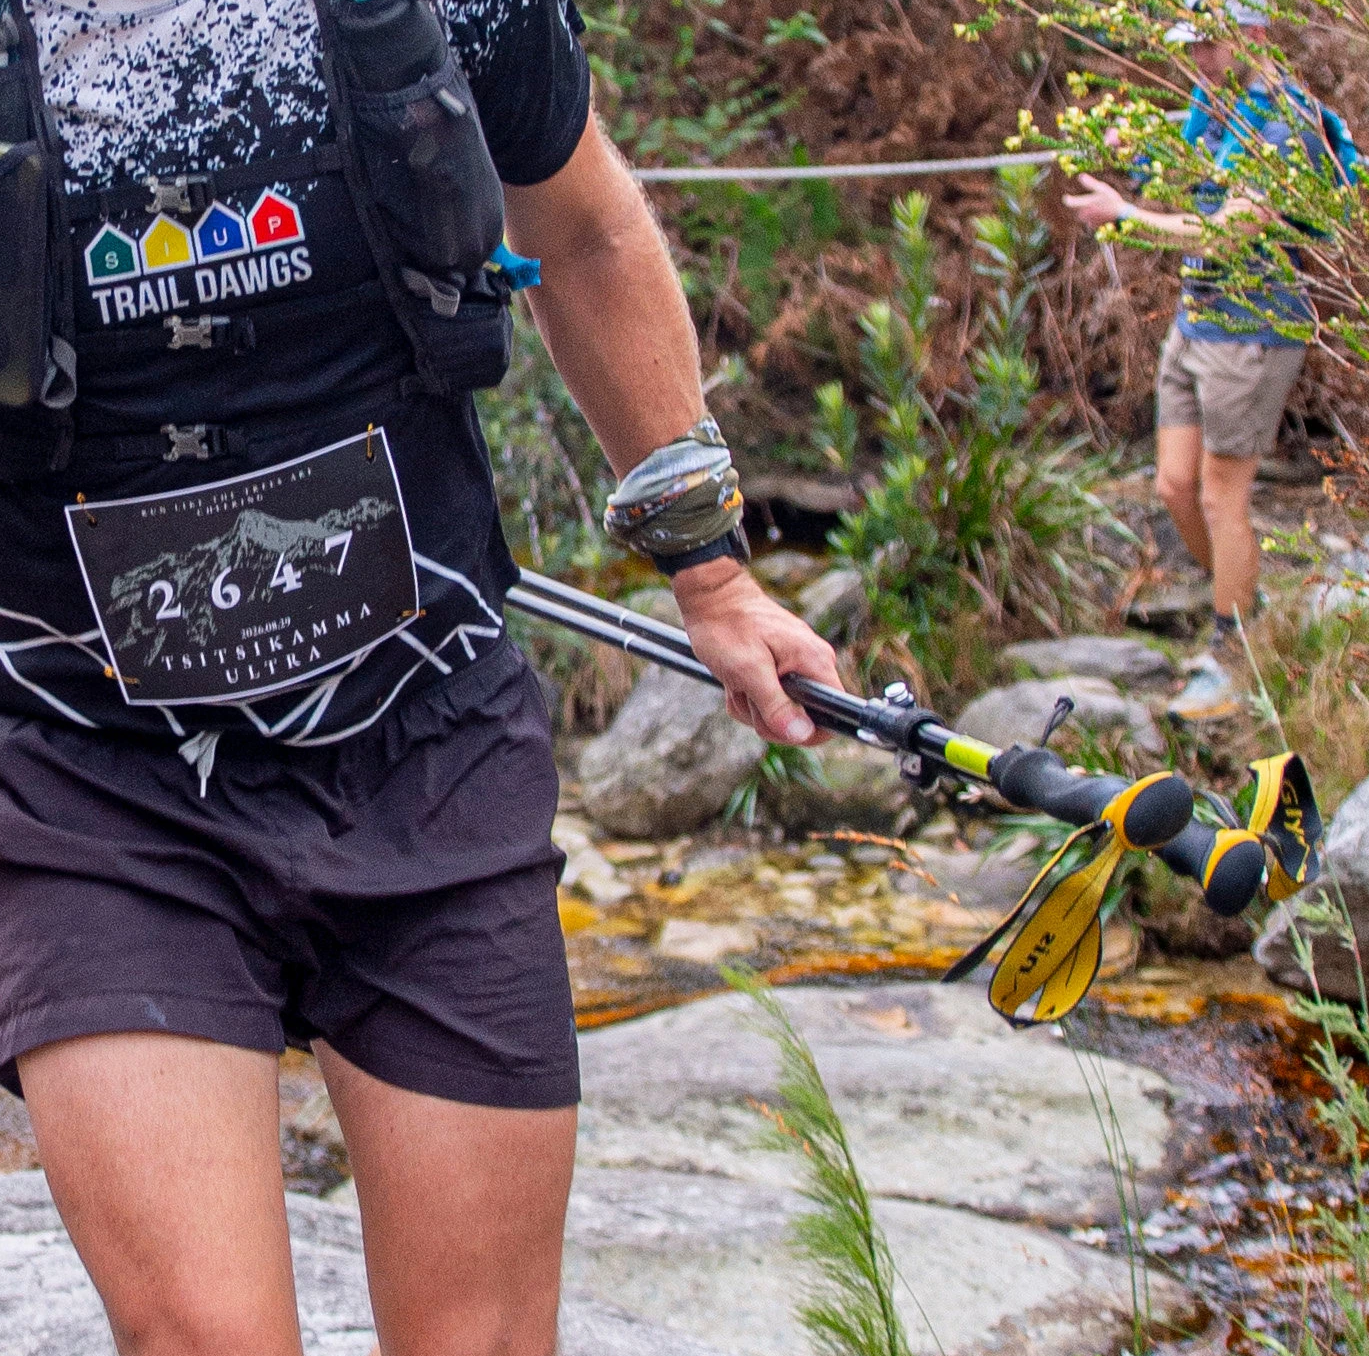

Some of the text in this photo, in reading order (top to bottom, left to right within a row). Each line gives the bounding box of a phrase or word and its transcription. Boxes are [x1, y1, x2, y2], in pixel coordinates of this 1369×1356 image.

[213, 227, 228, 246] U
[267, 215, 282, 234] P
[92, 245, 313, 325] TRAIL DAWGS
[149, 530, 353, 620] 2647
[161, 602, 372, 671] TSITSIKAMMA
[225, 645, 322, 684] ULTRA
